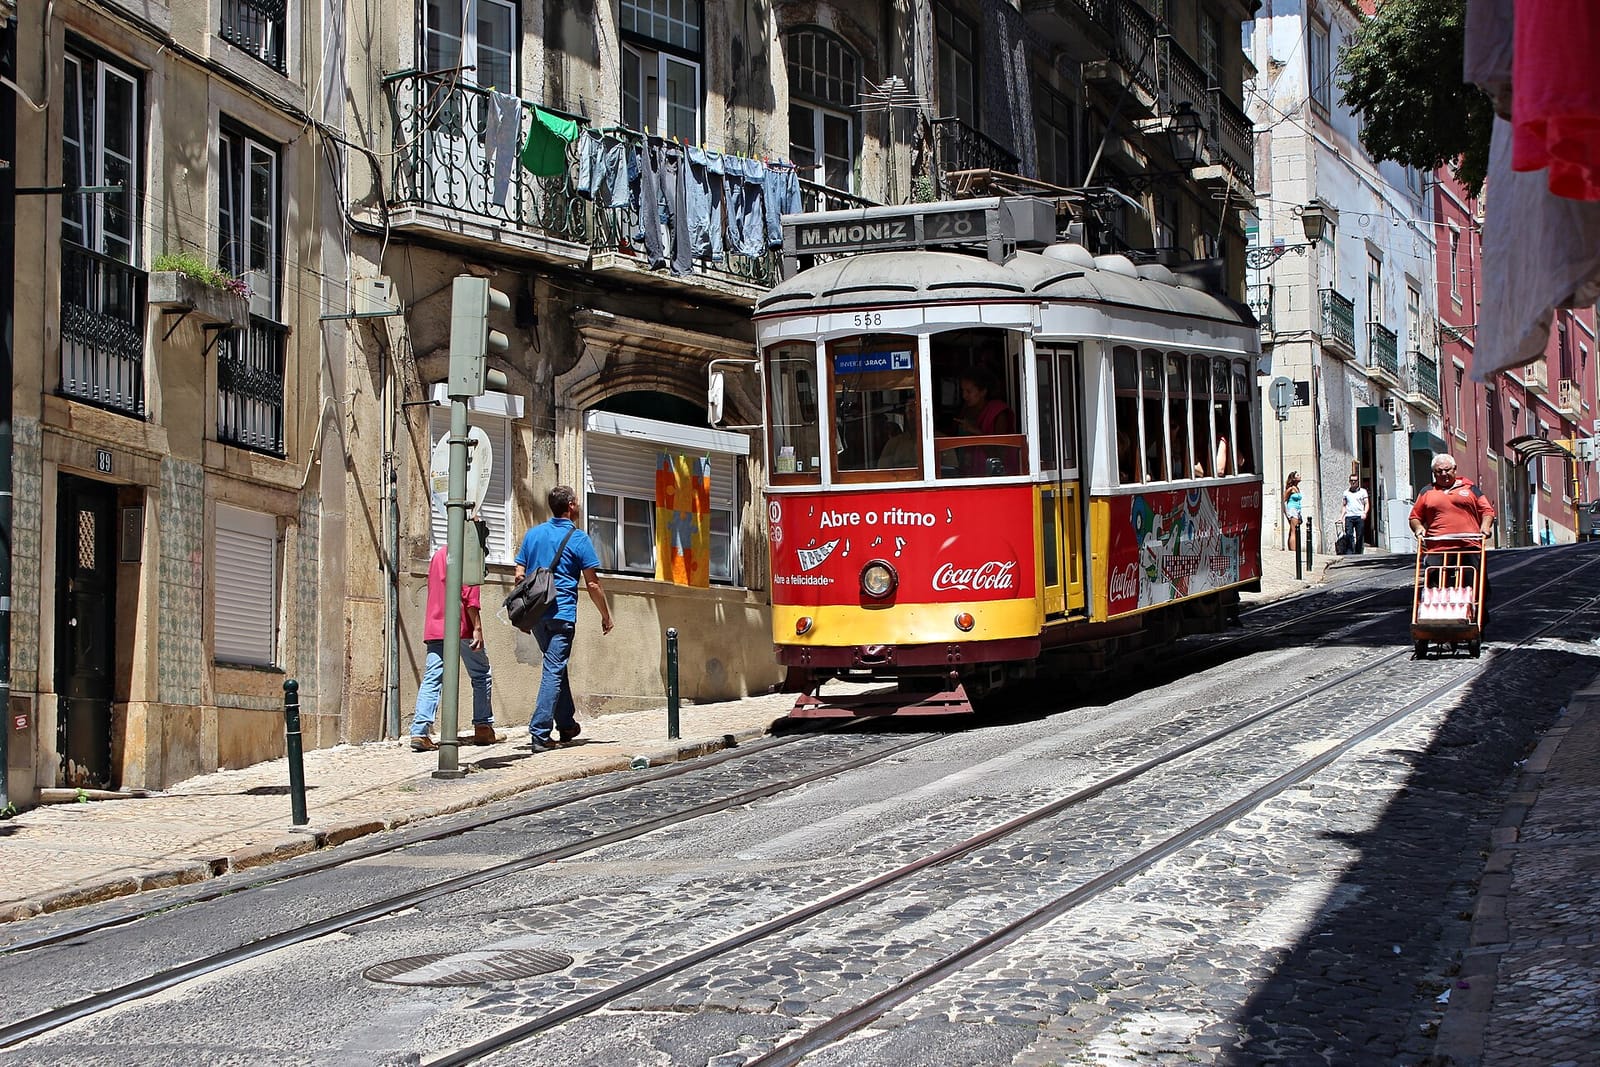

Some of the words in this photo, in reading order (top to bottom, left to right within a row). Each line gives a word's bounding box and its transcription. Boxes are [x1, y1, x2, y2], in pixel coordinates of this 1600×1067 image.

[802, 221, 907, 246] M.MONIZ
[936, 211, 973, 238] 28
[854, 313, 882, 327] 558
[99, 452, 111, 471] 89
[819, 510, 861, 529] Abre
[865, 514, 878, 526] o
[883, 507, 936, 527] ritmo
[774, 573, 785, 584] Abre
[931, 560, 1017, 591] Coca-Cola
